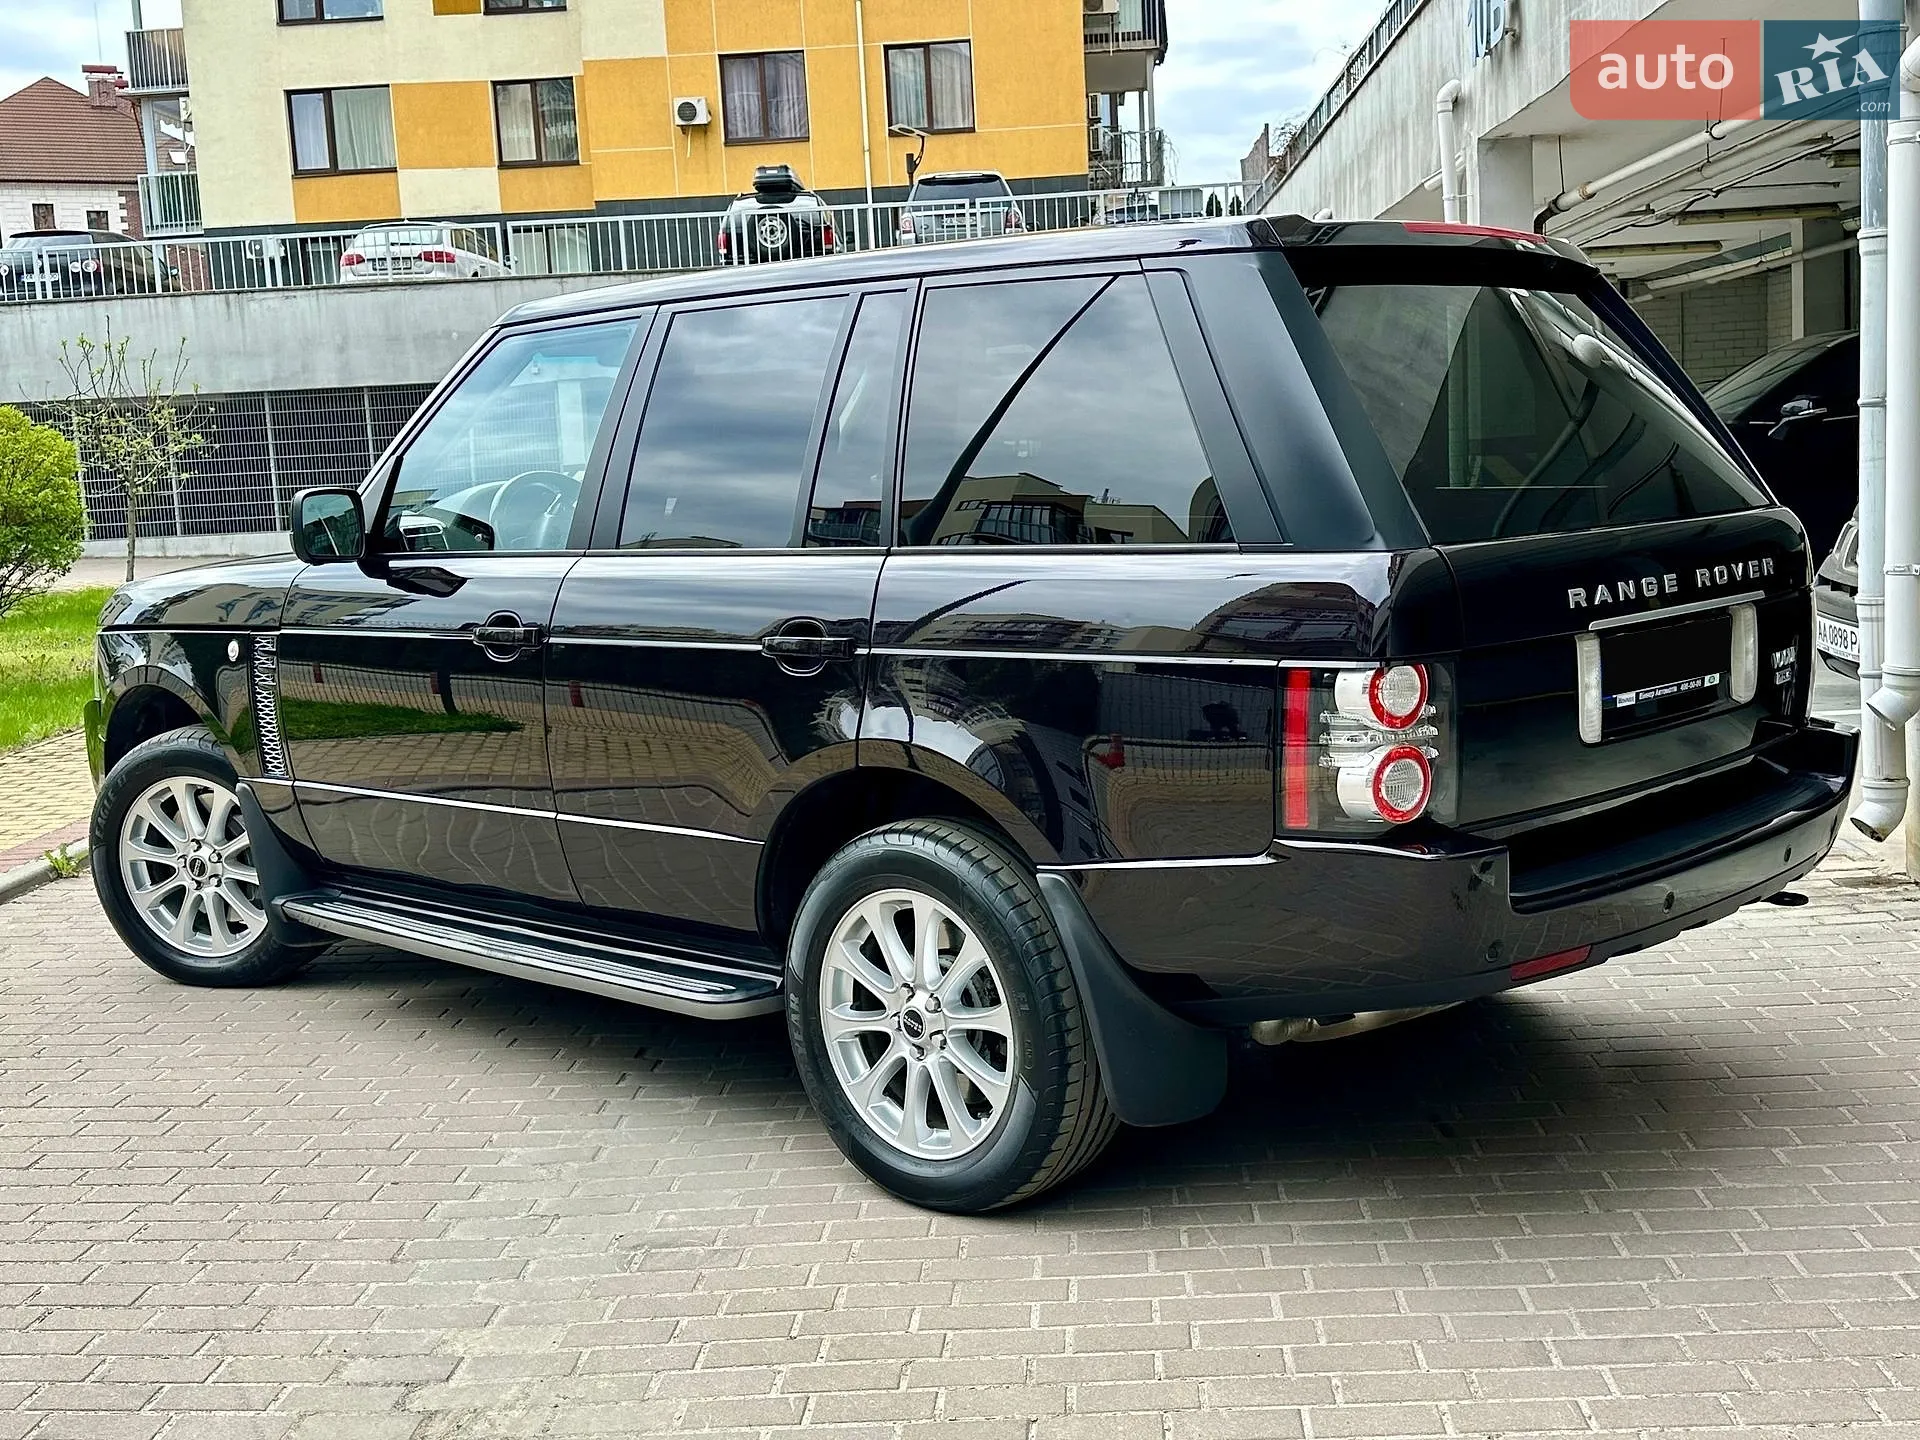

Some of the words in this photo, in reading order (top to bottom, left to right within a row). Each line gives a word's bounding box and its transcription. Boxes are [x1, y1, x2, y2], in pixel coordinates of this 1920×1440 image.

[1568, 573, 1678, 609] RANGE
[1696, 557, 1775, 588] ROVER
[1829, 624, 1849, 650] 0898
